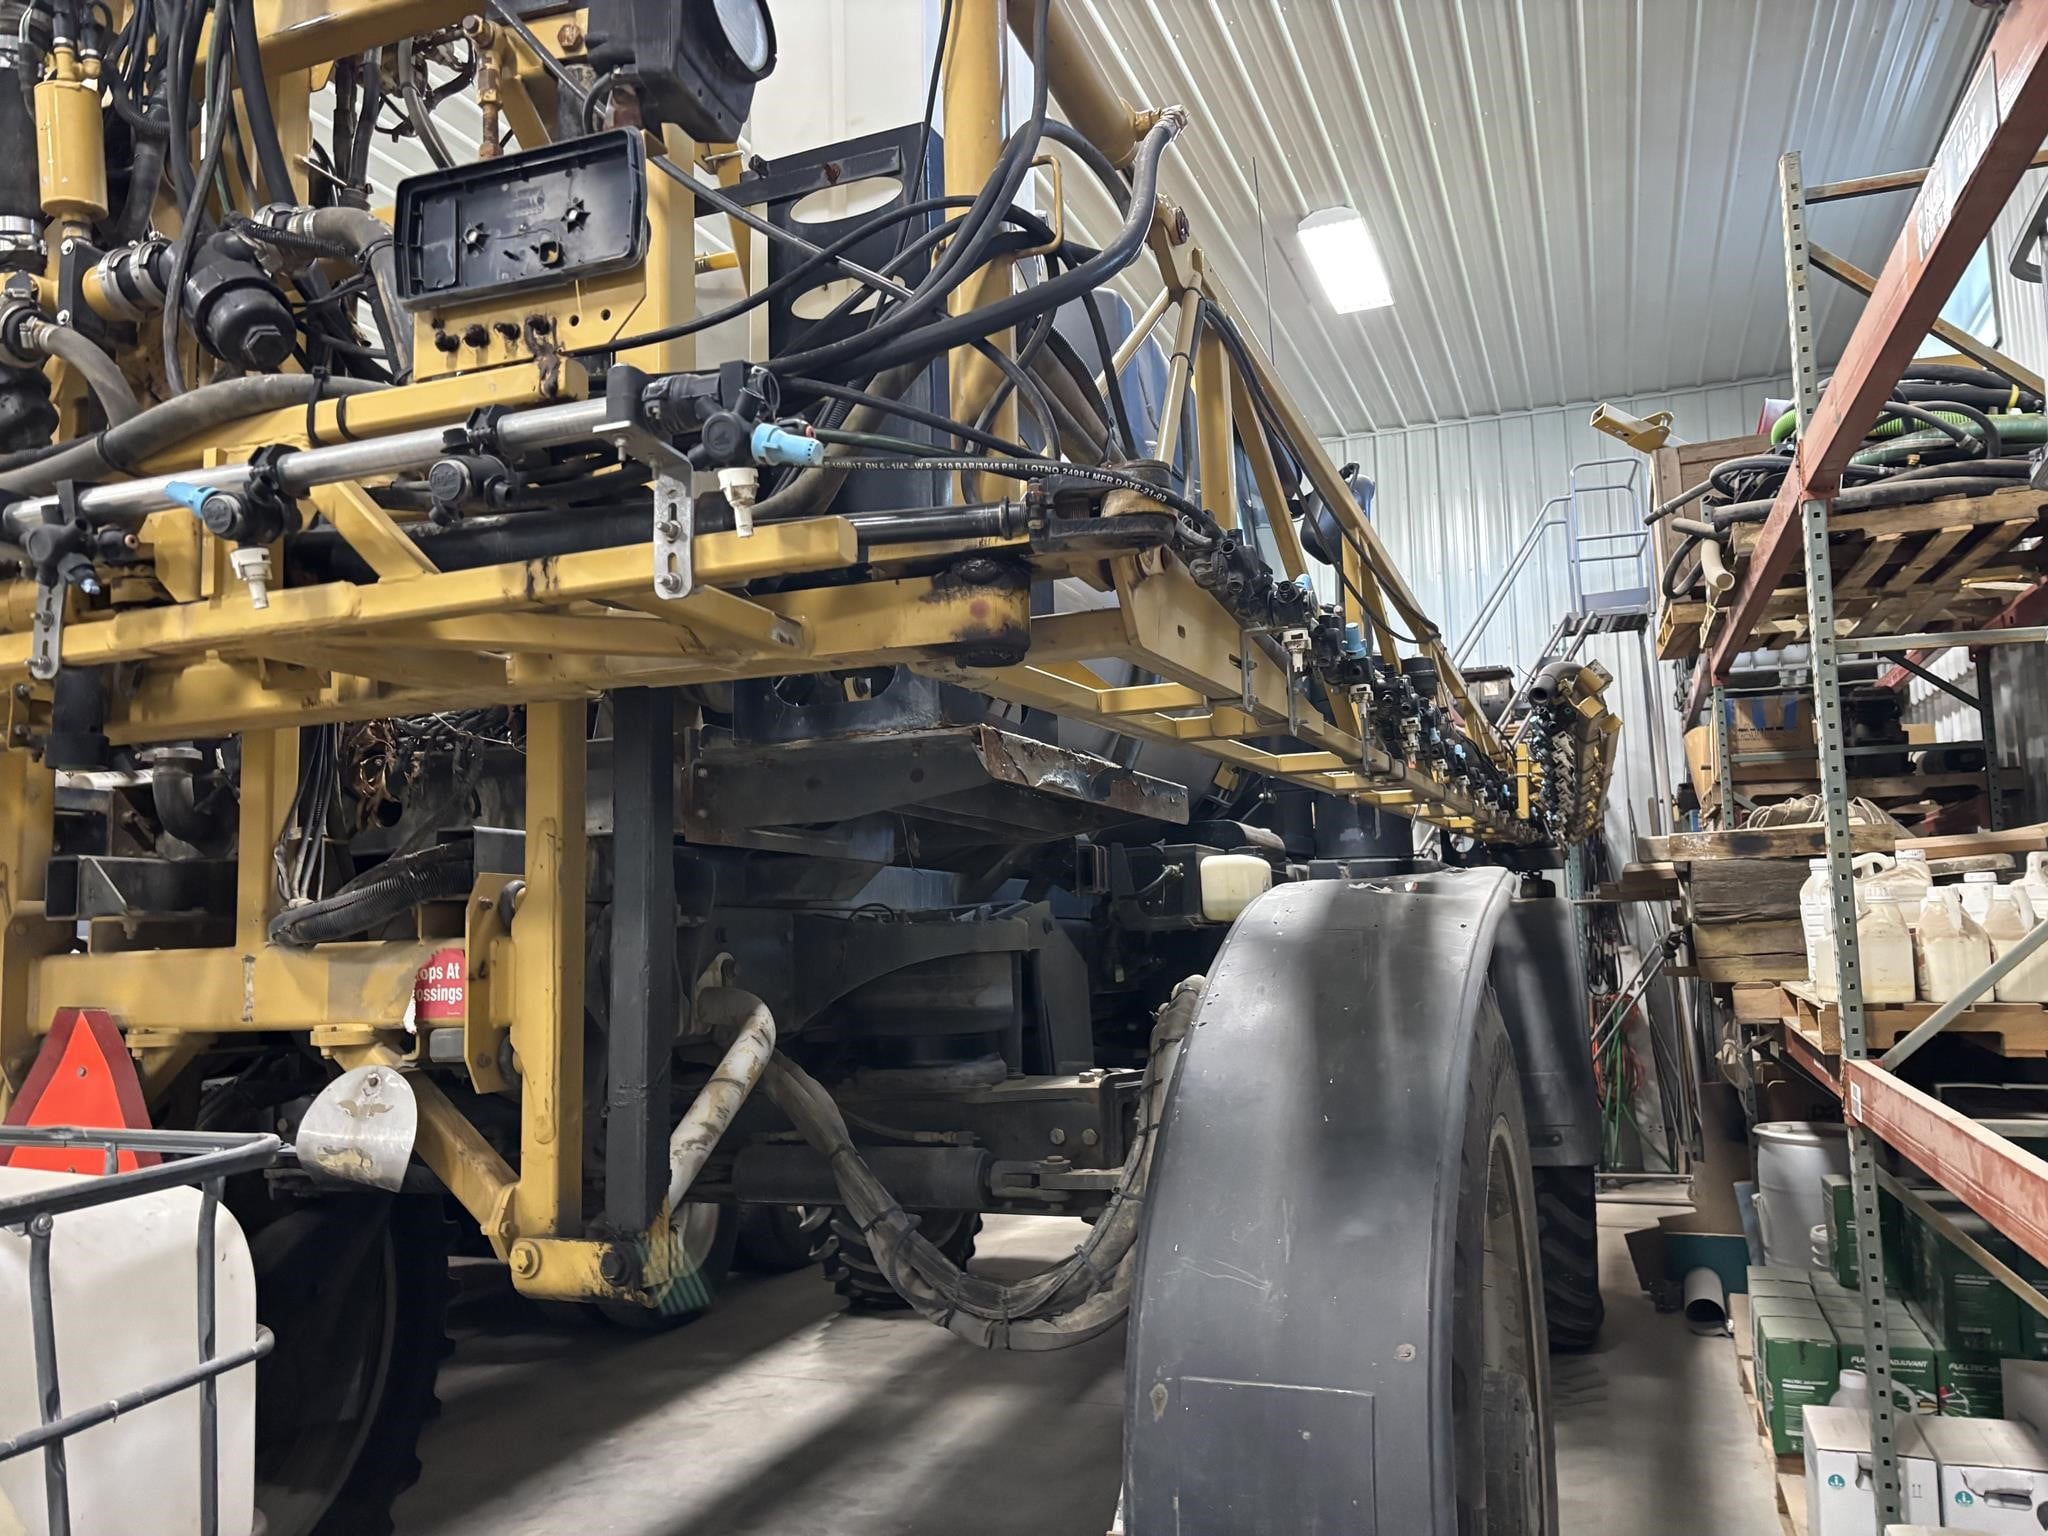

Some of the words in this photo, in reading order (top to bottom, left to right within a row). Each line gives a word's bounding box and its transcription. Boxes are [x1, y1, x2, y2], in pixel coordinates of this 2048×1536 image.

[417, 965, 443, 984] ops
[446, 962, 460, 979] At
[416, 985, 463, 1004] ossings
